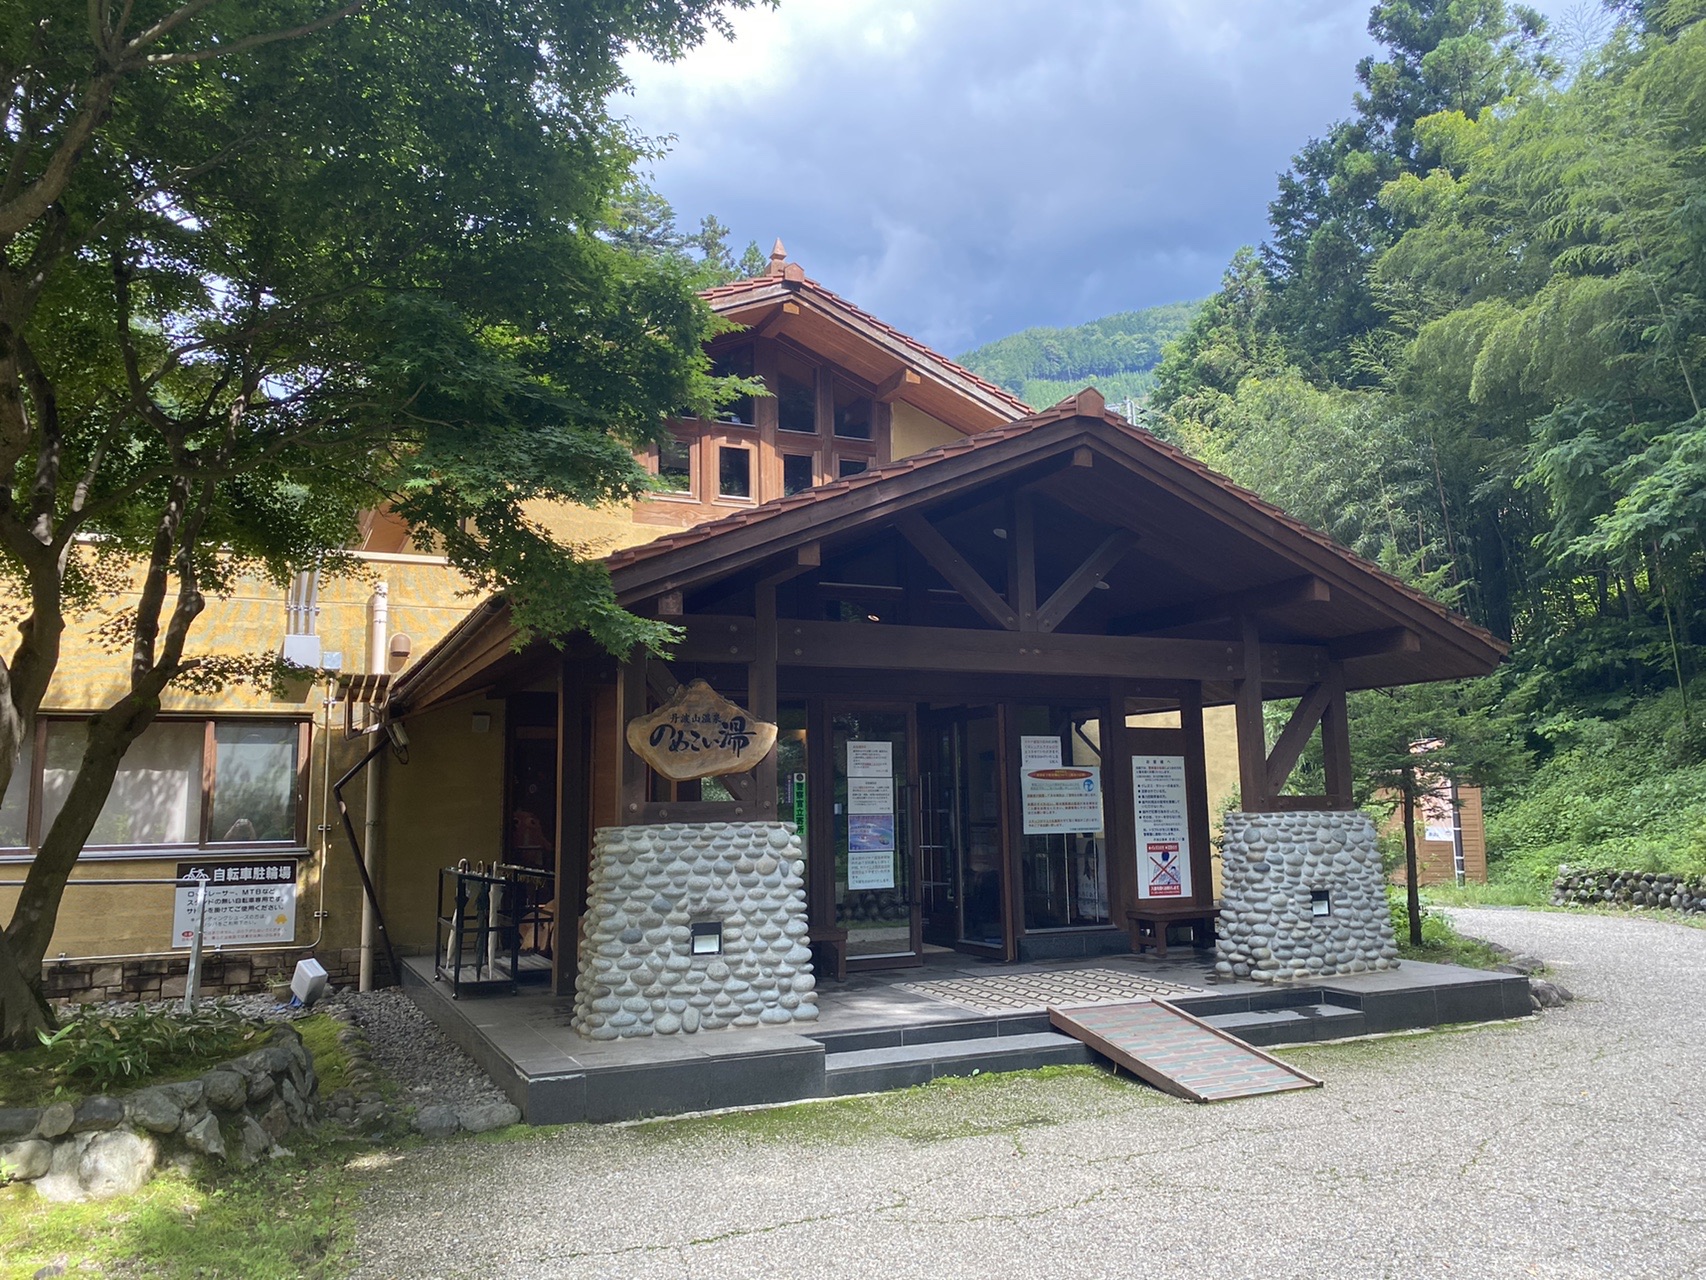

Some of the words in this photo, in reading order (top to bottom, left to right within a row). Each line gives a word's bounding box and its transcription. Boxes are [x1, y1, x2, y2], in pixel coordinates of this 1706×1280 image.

[670, 713, 723, 724] 丹波山温泉
[649, 715, 757, 758] のめこい湯
[213, 865, 292, 882] 自転車駐輪場
[187, 887, 276, 898] ロレーサー、MTBなど
[186, 895, 284, 907] スドの無い自転車専用です。
